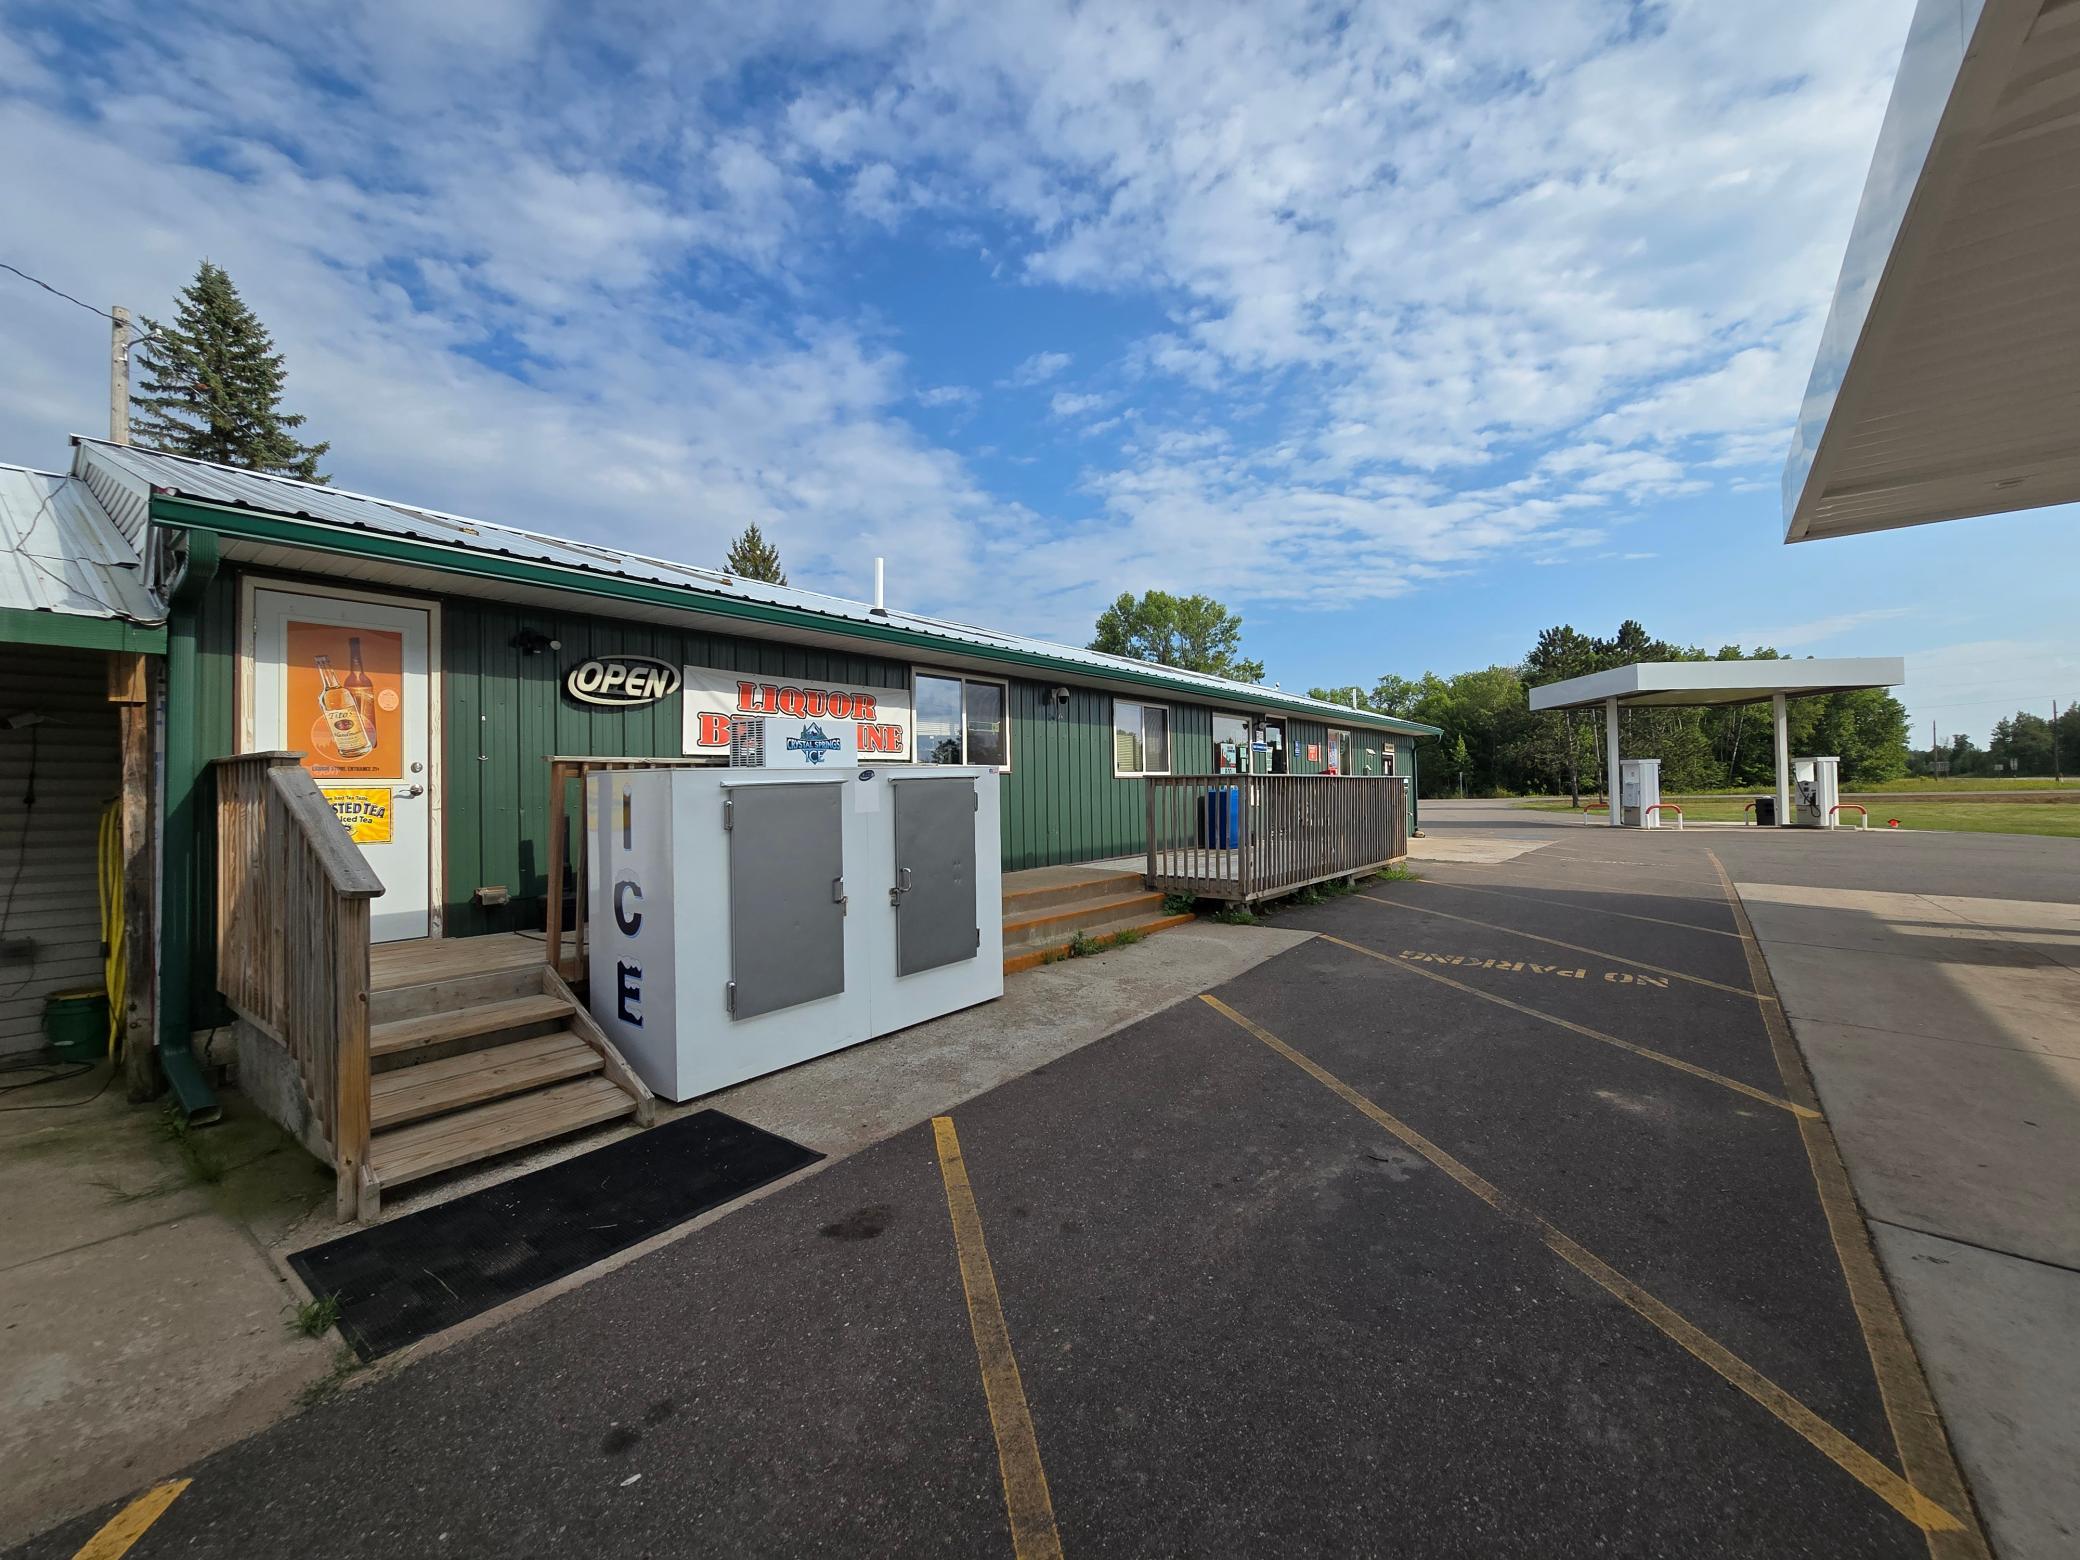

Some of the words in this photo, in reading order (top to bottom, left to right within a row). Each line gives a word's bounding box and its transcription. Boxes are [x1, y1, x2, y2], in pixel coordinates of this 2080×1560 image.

[576, 660, 670, 699] OPEN
[737, 680, 876, 721] LIQUOR
[787, 738, 813, 750] CRYSTAL
[814, 738, 841, 750] SPRINGS
[857, 722, 904, 754] INE
[805, 750, 826, 763] ICE
[332, 802, 362, 814] STED
[363, 803, 386, 818] TEA
[359, 816, 373, 824] Tea
[613, 783, 644, 1029] ICE
[1604, 973, 1669, 988] NO
